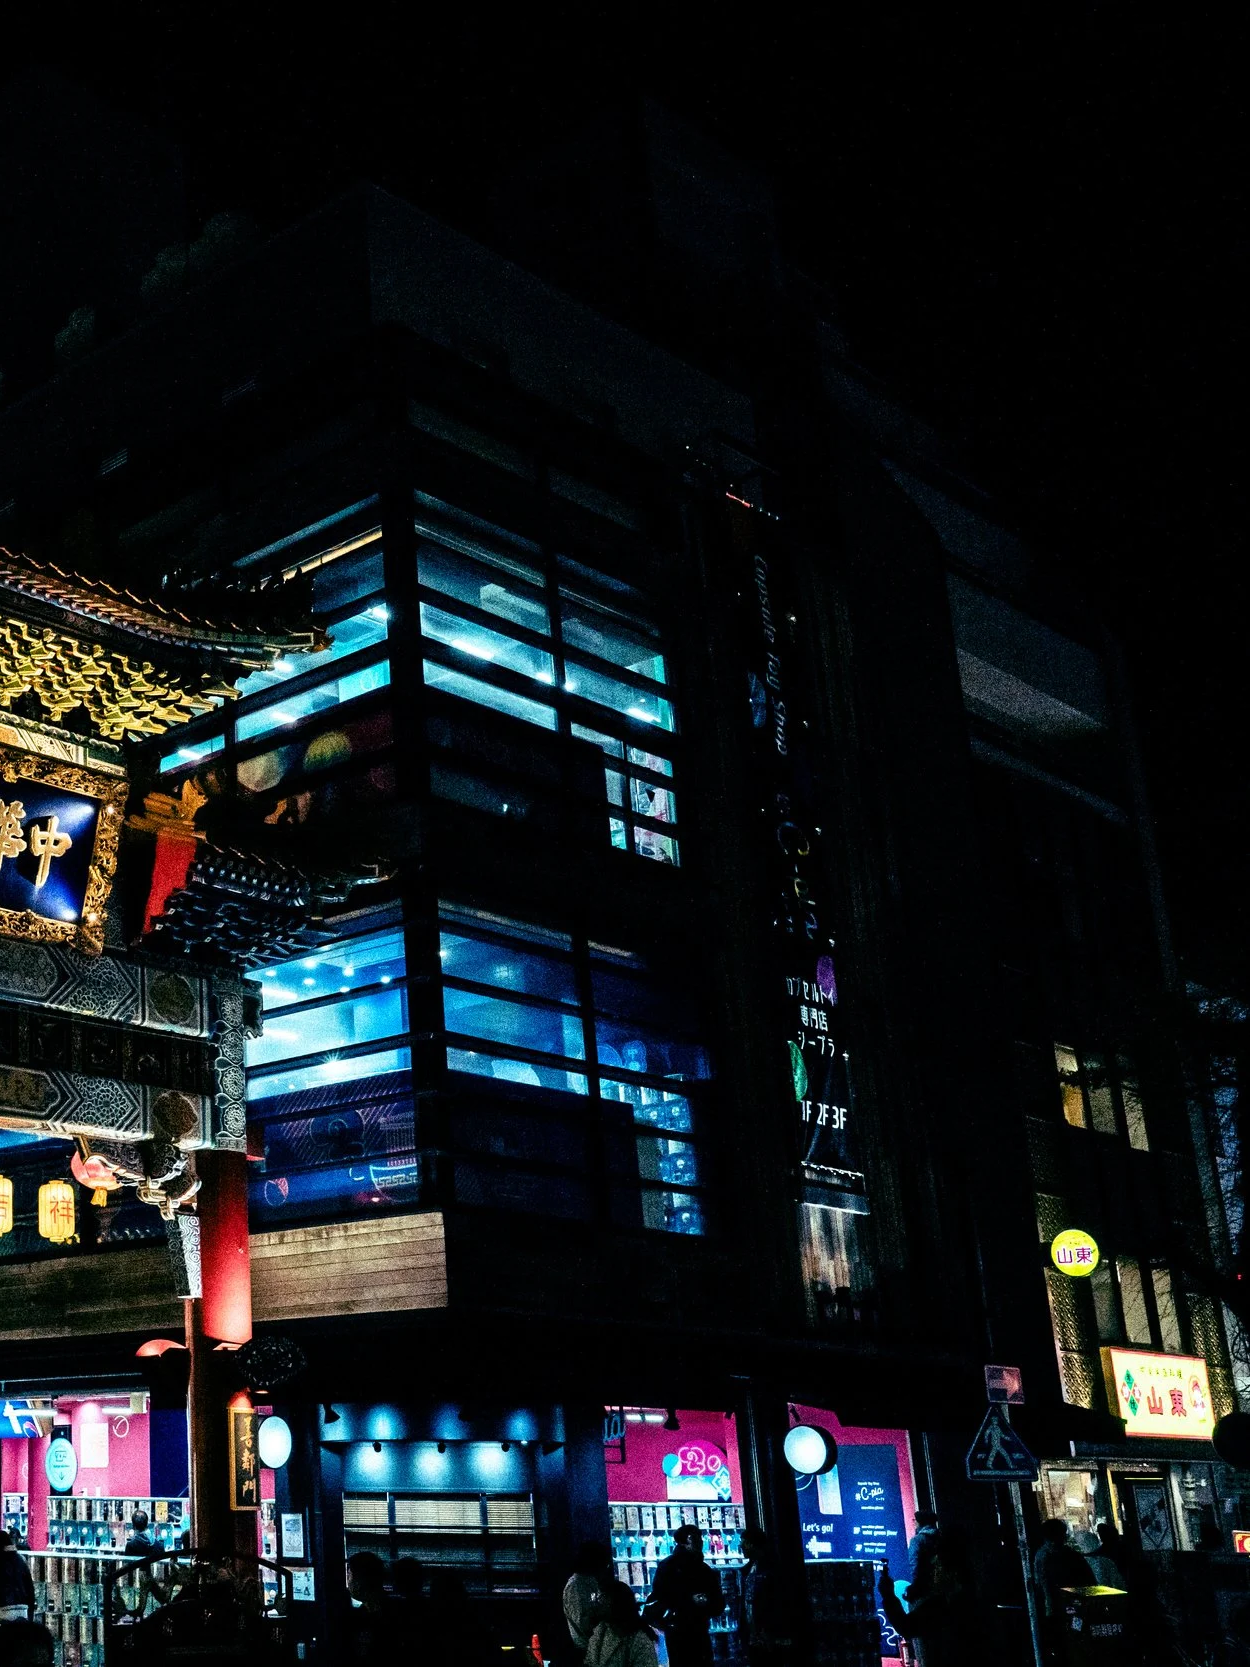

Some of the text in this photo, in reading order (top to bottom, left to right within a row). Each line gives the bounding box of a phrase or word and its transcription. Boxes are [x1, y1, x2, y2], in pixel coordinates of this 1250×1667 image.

[800, 1005, 829, 1033] 専門店
[798, 1030, 836, 1058] シープラ
[817, 1103, 829, 1126] 2F
[832, 1106, 847, 1129] 3F
[50, 1196, 74, 1224] 祥
[1057, 1247, 1093, 1264] 山東
[1147, 1386, 1187, 1417] 山東
[802, 1522, 834, 1534] Let's go!
